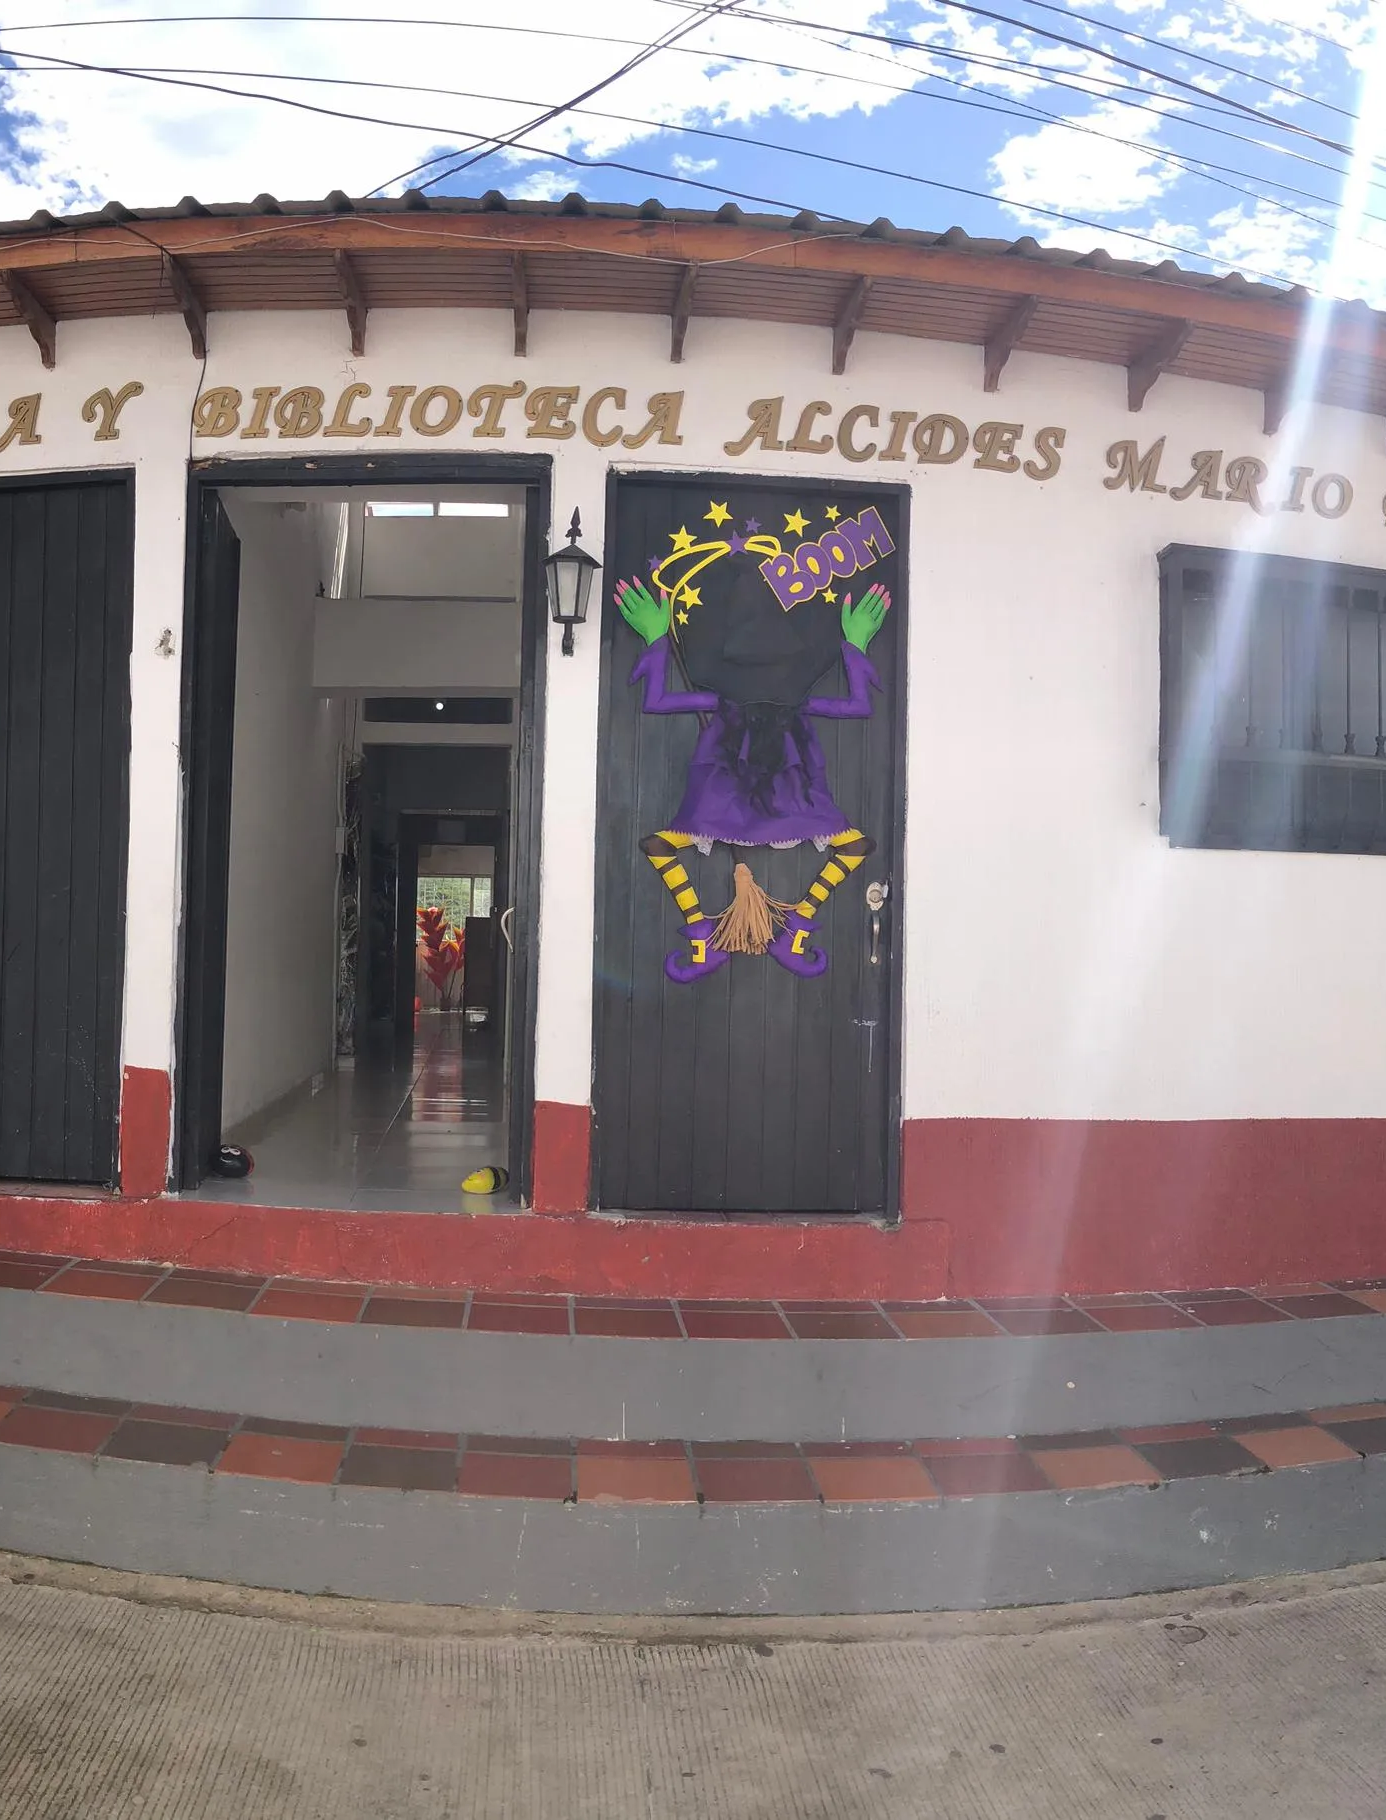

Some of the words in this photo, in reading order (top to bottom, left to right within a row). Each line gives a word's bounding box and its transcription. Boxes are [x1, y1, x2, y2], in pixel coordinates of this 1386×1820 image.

[81, 381, 144, 441] Y
[193, 381, 684, 449] BIBLIOTECA
[723, 396, 1066, 481] ALCIDES
[1102, 436, 1354, 519] MARIO
[758, 505, 896, 612] BOOM
